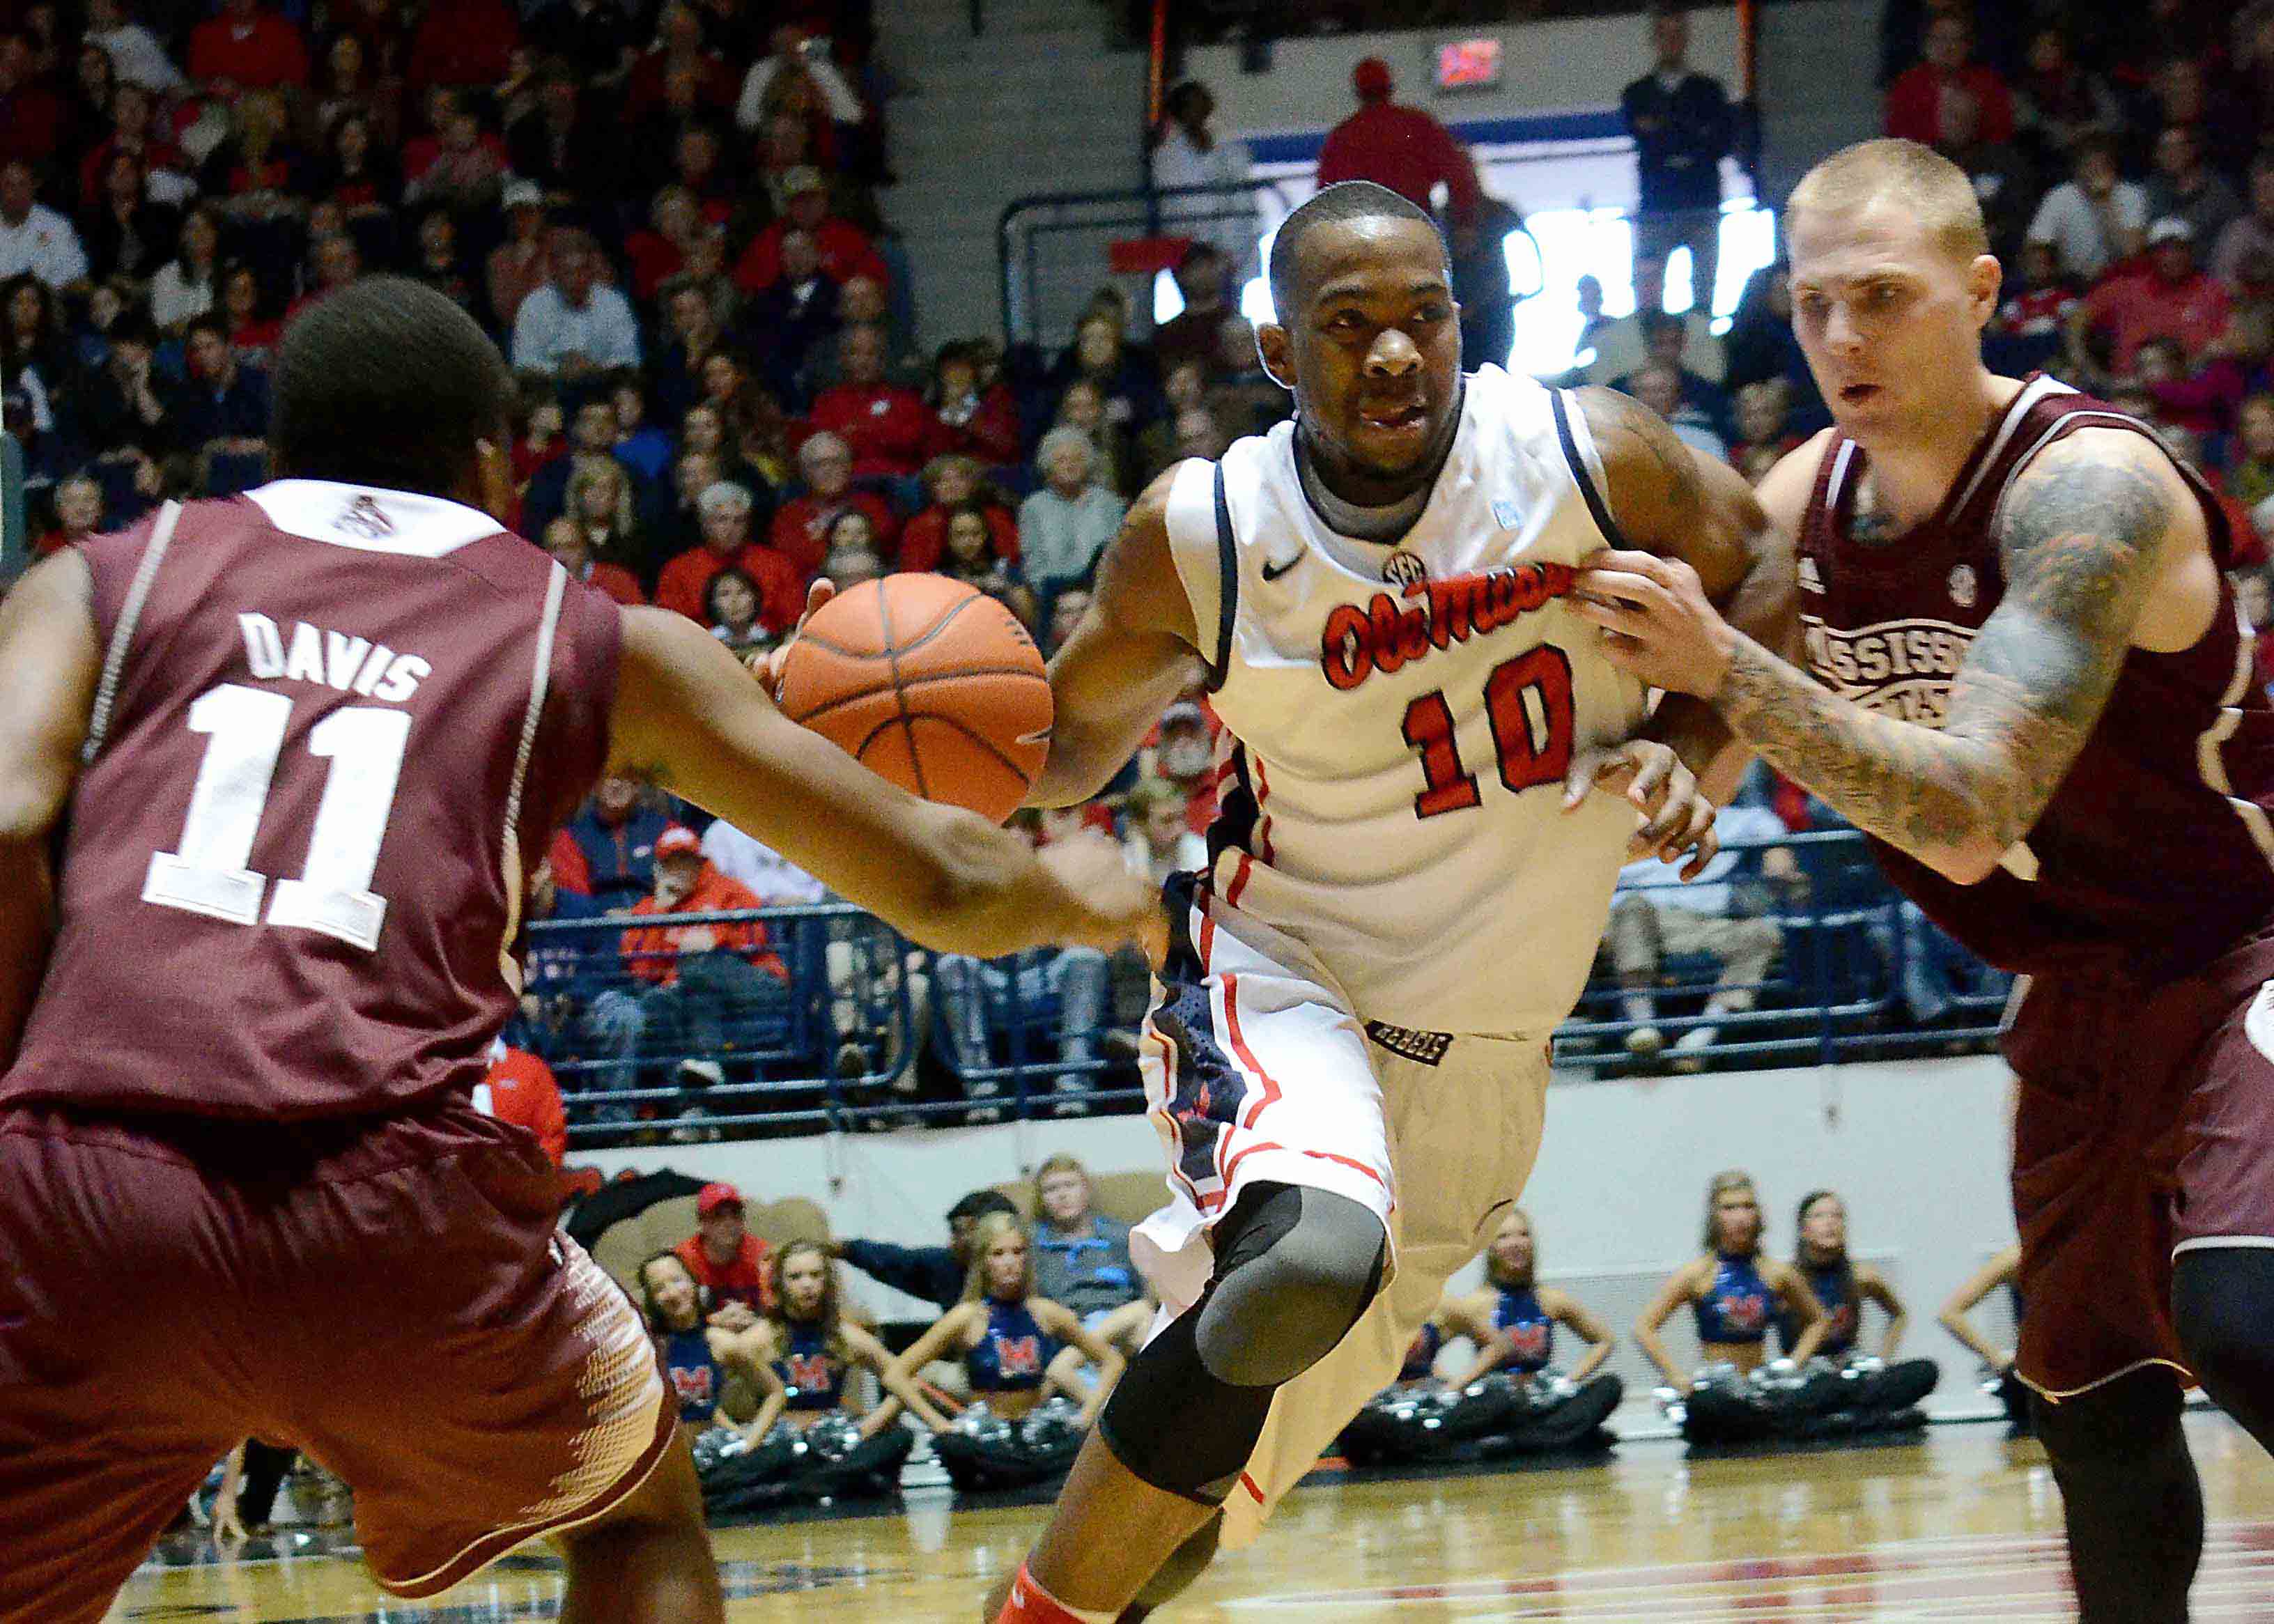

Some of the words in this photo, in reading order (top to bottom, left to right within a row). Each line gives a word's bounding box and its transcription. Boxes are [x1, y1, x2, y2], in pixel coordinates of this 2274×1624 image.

[238, 612, 433, 702] DAVIS
[1322, 594, 1430, 690] Ole
[1401, 642, 1576, 819] 10
[140, 683, 412, 952] 11
